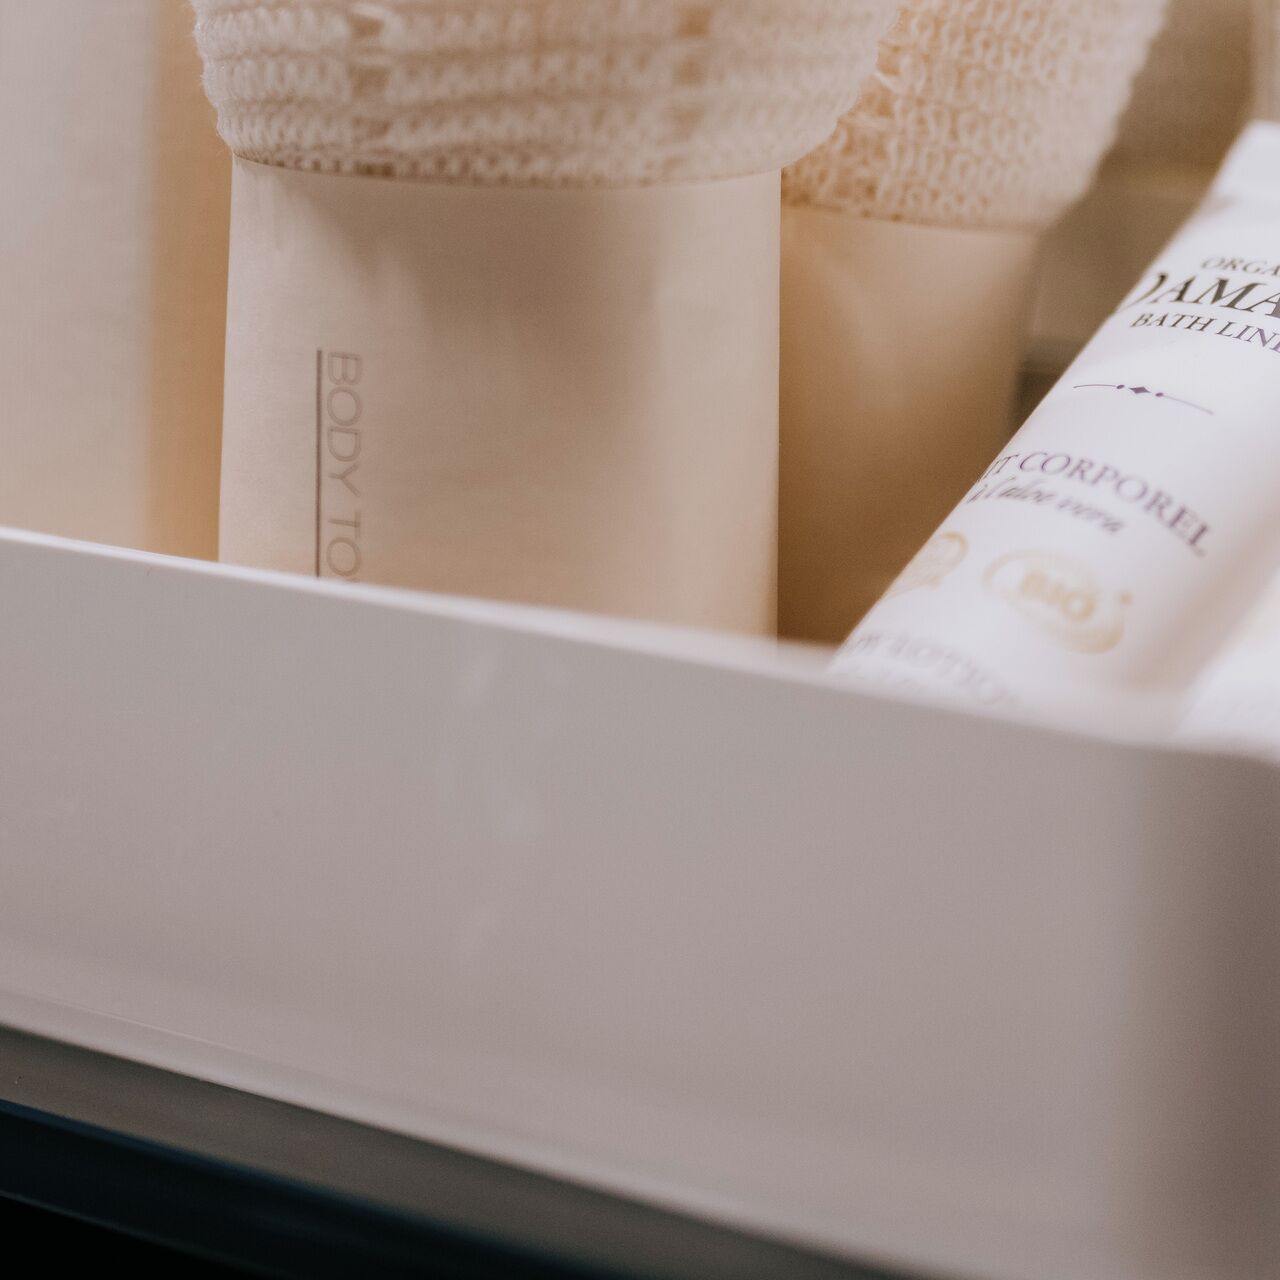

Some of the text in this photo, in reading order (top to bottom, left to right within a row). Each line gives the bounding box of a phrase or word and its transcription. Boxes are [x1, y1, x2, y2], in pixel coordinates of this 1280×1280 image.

[1131, 312, 1214, 332] BATH
[326, 351, 362, 582] BODY TO
[1020, 452, 1210, 558] CORPOREL
